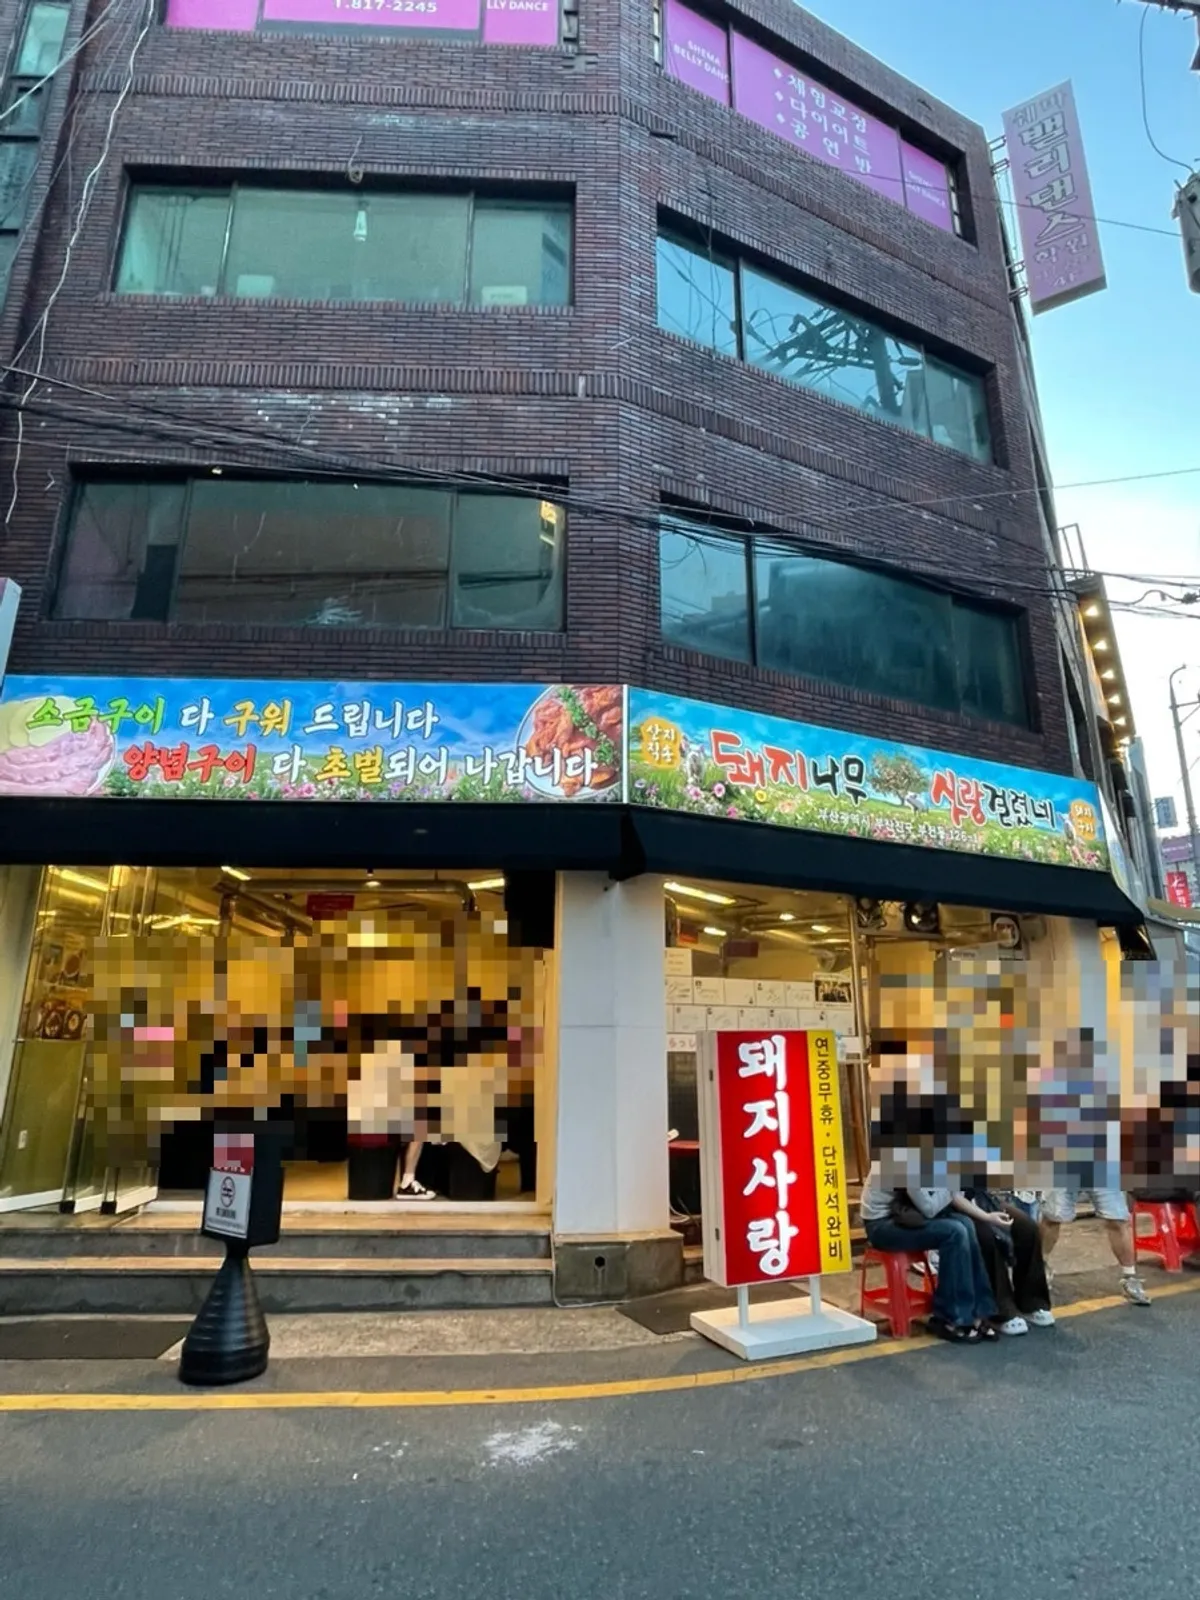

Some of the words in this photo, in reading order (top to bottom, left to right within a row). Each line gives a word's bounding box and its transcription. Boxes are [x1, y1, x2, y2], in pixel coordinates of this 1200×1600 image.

[509, 0, 549, 11] DANCE
[673, 43, 701, 67] BELLY
[25, 696, 166, 735] 소금구이
[180, 697, 215, 736] 다
[224, 698, 292, 737] 구워
[303, 700, 440, 739] 드립니다
[646, 722, 676, 742] 산지
[122, 740, 257, 784] 양념구이
[271, 743, 307, 783] 다
[315, 745, 449, 786] 초벌되어
[464, 746, 599, 787] 나갑니다
[710, 728, 869, 807] 돼지나무
[931, 767, 1057, 829] 사랑걸렸네
[814, 1036, 834, 1126] 연중무휴
[737, 1034, 799, 1276] 돼지사랑
[822, 1144, 844, 1263] 단체석완비
